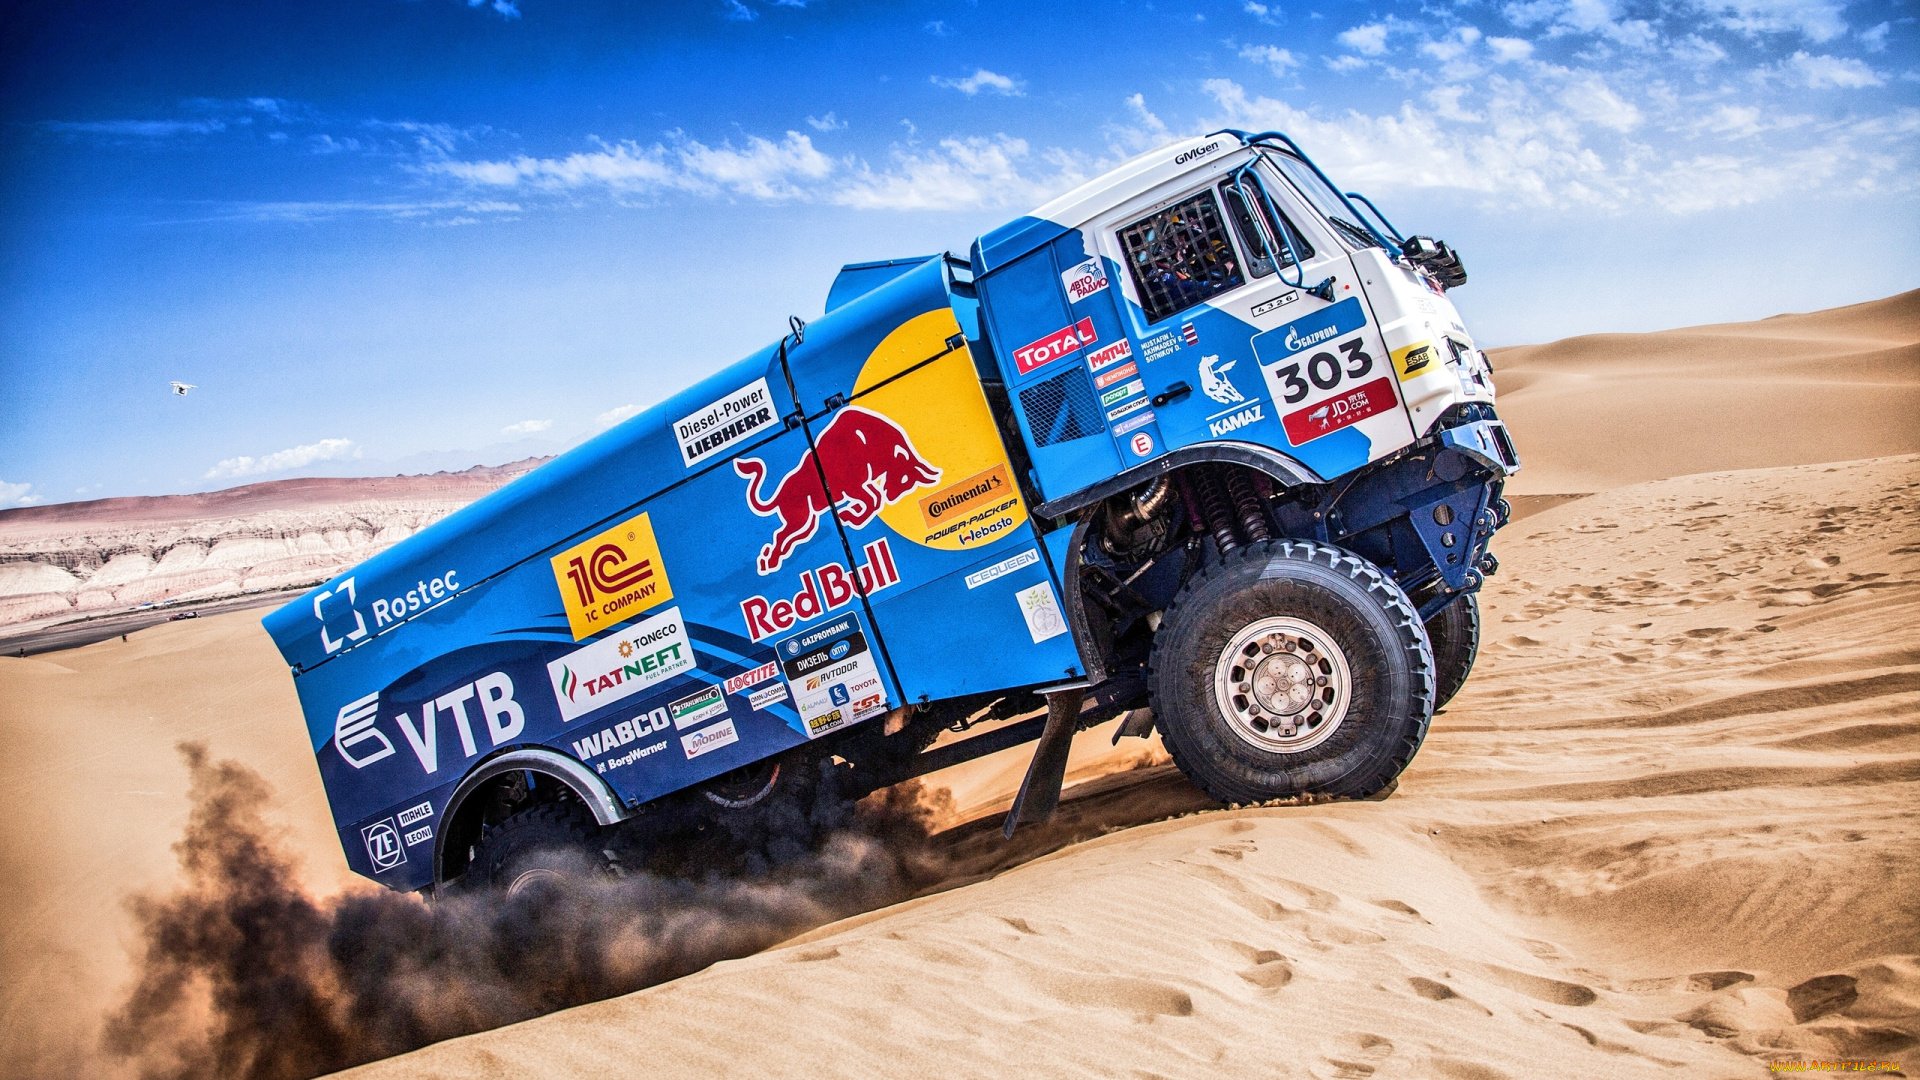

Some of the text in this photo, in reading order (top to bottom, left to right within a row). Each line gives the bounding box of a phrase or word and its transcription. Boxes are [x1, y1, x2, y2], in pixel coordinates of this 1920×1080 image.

[1175, 142, 1218, 164] GMGen
[1070, 276, 1092, 293] АВТО
[1076, 277, 1108, 298] РАДИО
[1018, 330, 1092, 366] TOTAL
[1141, 333, 1169, 350] MUSTAFIN
[1144, 338, 1176, 356] AKHMADEEV
[1300, 325, 1338, 347] GAZPROM
[1090, 340, 1130, 368] МАТЧ!
[1145, 347, 1174, 364] SOTNIKOV
[1406, 352, 1429, 366] ESAB
[1104, 364, 1137, 382] ЧЕМПИОНАТ
[1276, 336, 1372, 403] 303
[679, 388, 763, 439] Diesel-Power
[1209, 405, 1265, 438] KAMAZ
[686, 407, 771, 460] LIEBHERR
[1135, 437, 1148, 453] E
[928, 479, 992, 518] Continental
[925, 498, 1018, 544] POWER-PACKER
[959, 517, 1013, 545] Webasto
[968, 552, 1036, 585] ICEQUEEN
[372, 570, 459, 628] Rostec
[585, 582, 656, 623] 1C COMPANY
[742, 540, 898, 640] Red Bull
[633, 624, 677, 649] TANECO
[802, 621, 850, 647] GAZPROMBANK
[583, 642, 682, 696] TATNEFT
[645, 660, 688, 681] FUEL PARTNER
[727, 662, 775, 693] LOCTITE
[820, 660, 858, 682] AVTODOR
[850, 678, 877, 692] TOYOTA
[395, 671, 525, 774] VTB
[572, 707, 670, 761] WABCO
[692, 727, 732, 748] MODINE
[608, 740, 668, 770] BorgWarner
[401, 804, 430, 824] MAHLE
[370, 830, 400, 860] ZF
[406, 828, 431, 844] LEONI
